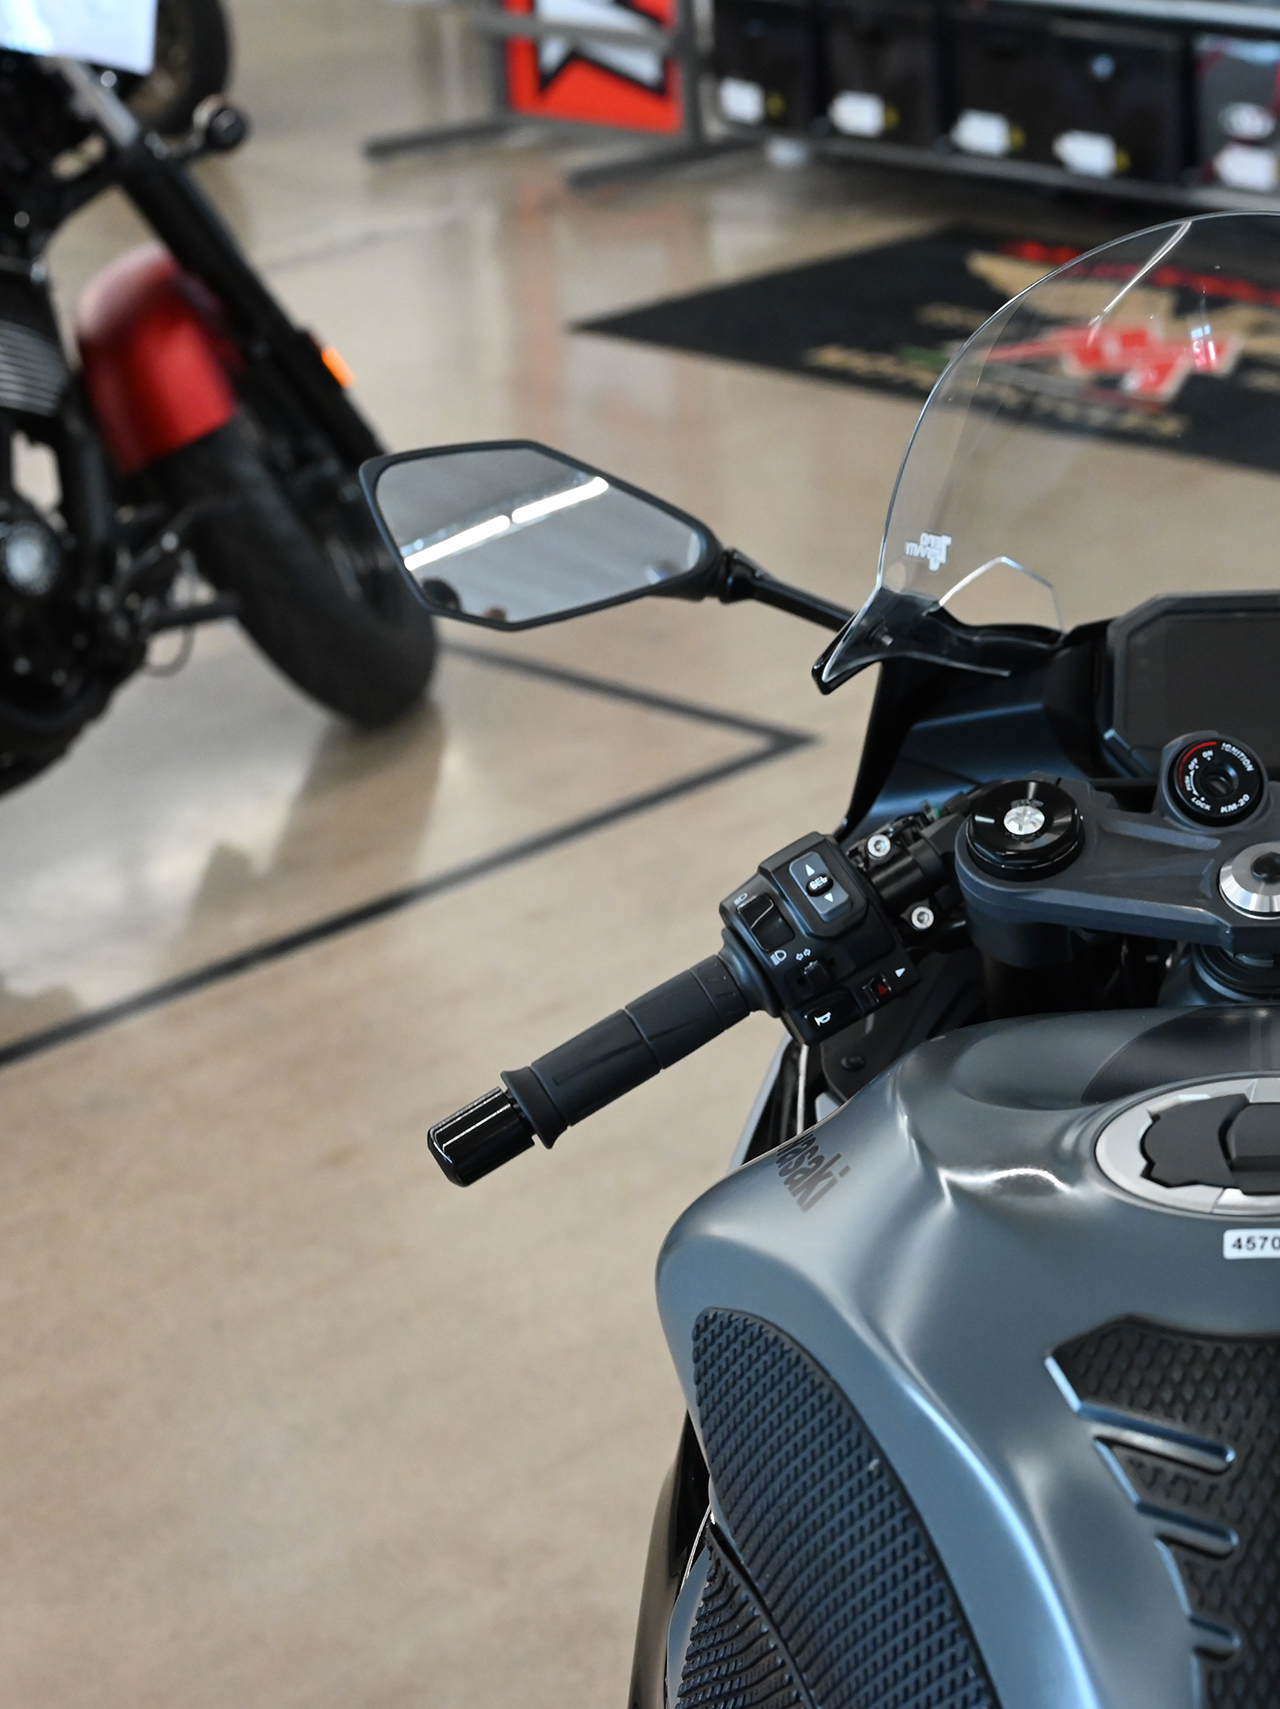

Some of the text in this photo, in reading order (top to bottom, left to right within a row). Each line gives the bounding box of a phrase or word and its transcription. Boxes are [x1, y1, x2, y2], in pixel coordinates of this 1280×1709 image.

[1221, 742, 1254, 771] IGNITION
[1191, 797, 1211, 811] LOCK
[1220, 793, 1250, 813] KM-20
[809, 875, 828, 890] SEL
